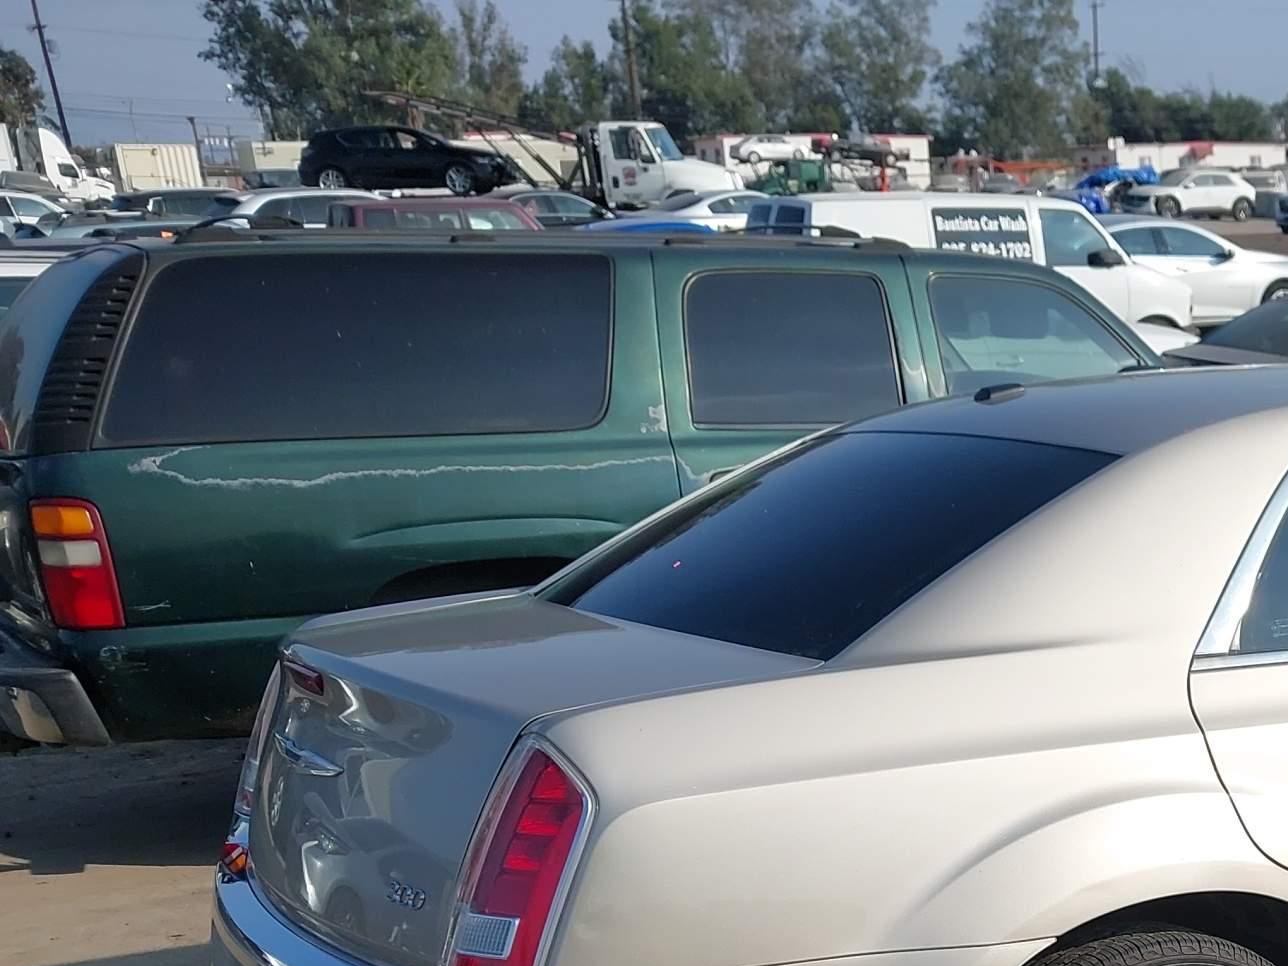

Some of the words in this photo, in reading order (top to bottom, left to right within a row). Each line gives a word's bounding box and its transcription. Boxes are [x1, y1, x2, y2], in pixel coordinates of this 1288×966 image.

[935, 214, 980, 231] Bautista
[980, 215, 999, 231] Car
[999, 214, 1027, 231] Wash
[387, 880, 426, 911] 300
